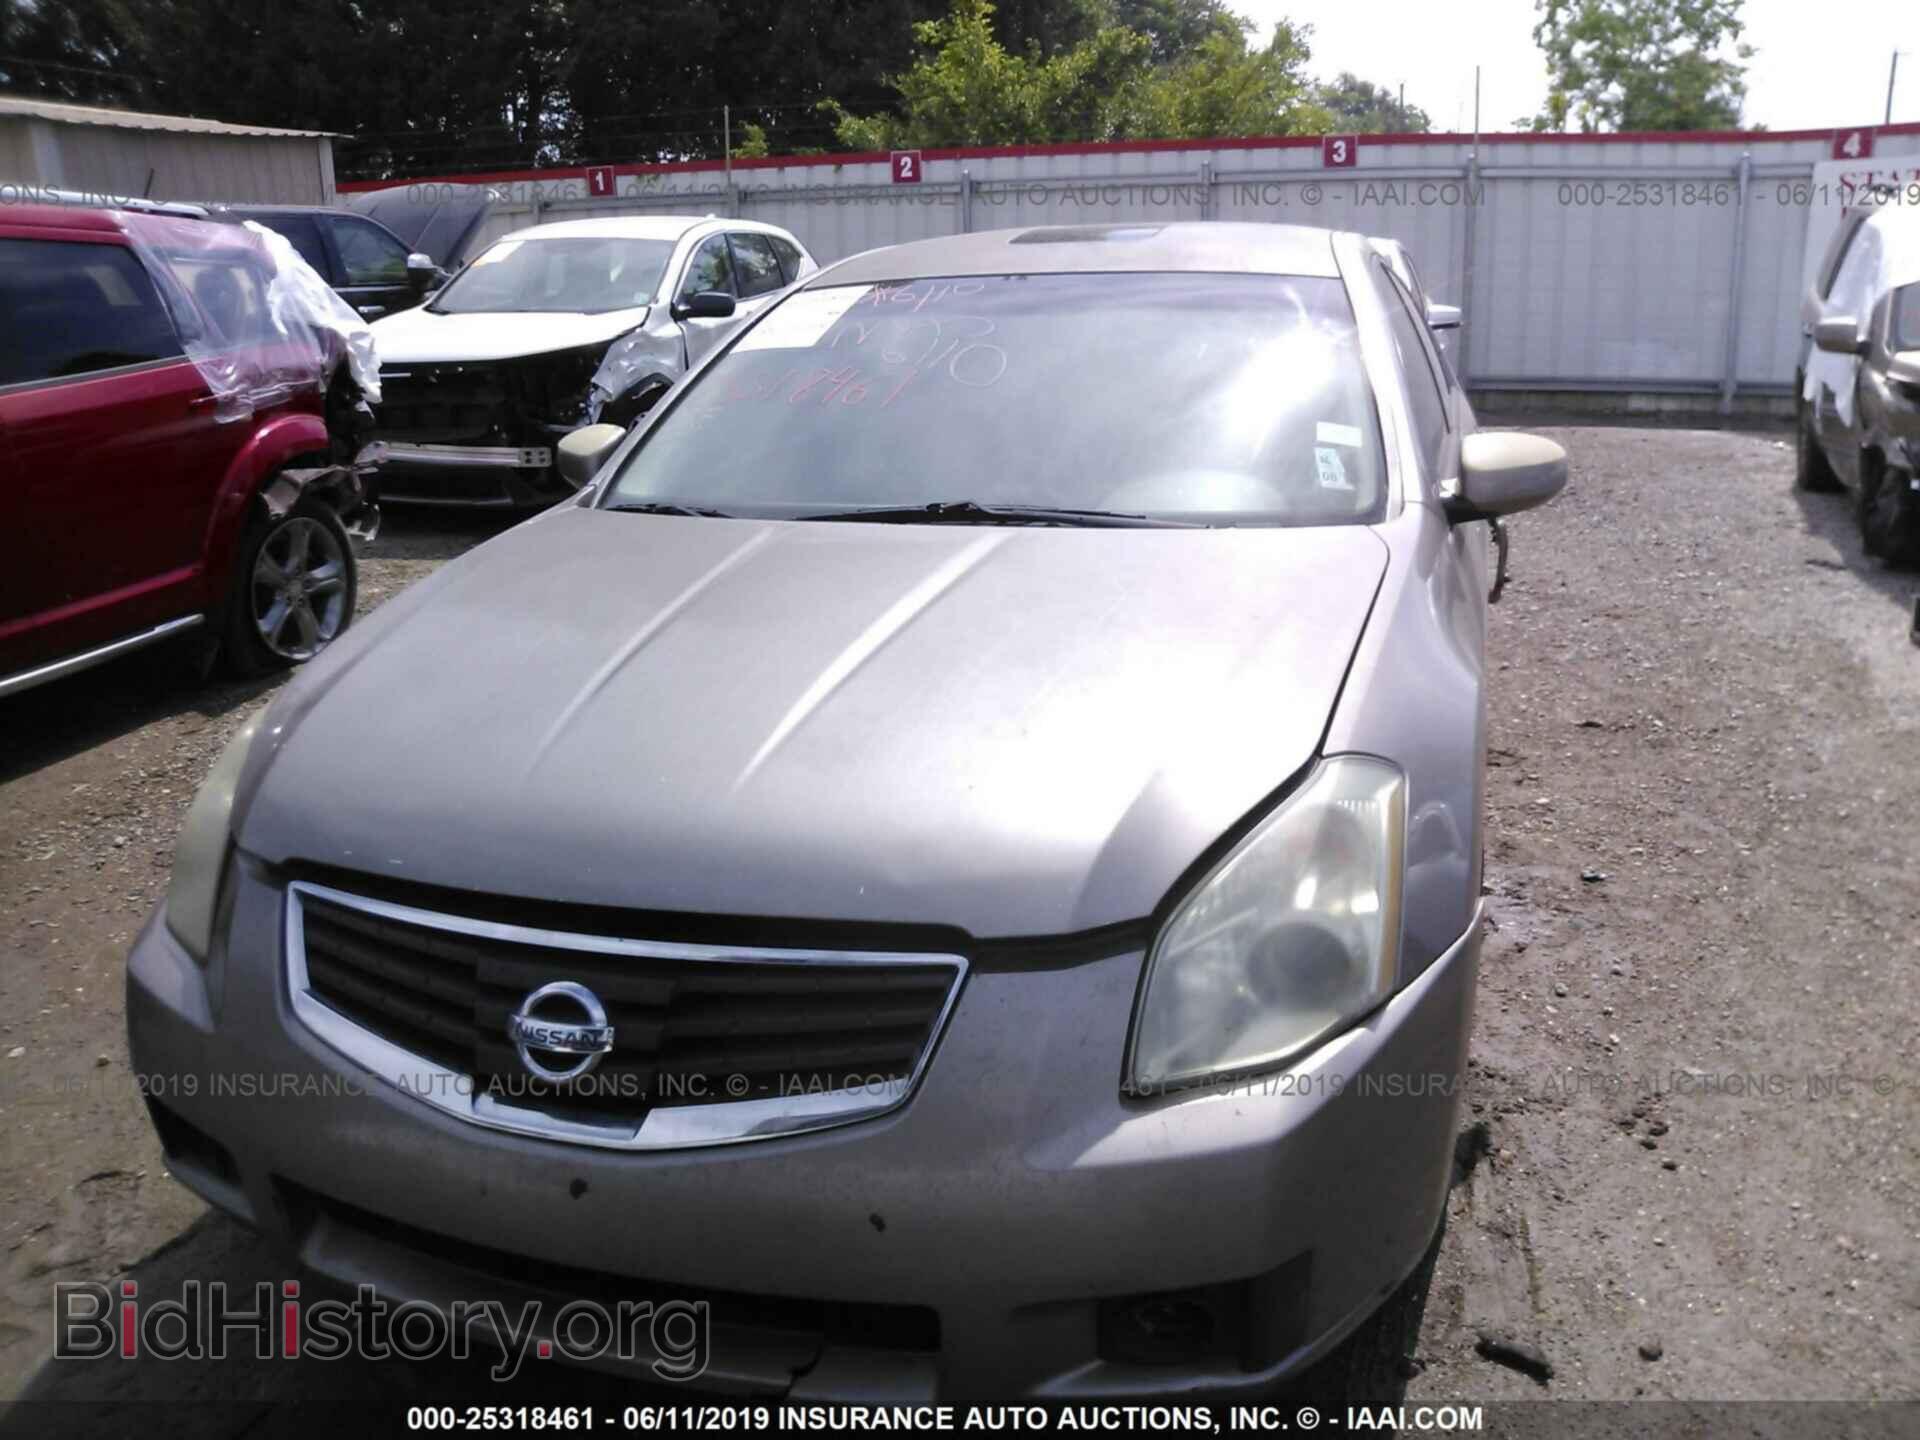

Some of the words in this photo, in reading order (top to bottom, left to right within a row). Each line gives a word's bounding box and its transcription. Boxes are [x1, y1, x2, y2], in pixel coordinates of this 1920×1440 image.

[1332, 141, 1347, 162] 3
[1843, 132, 1861, 156] 4
[900, 156, 913, 177] 2
[595, 171, 605, 191] 1
[515, 1024, 600, 1050] NISSAN
